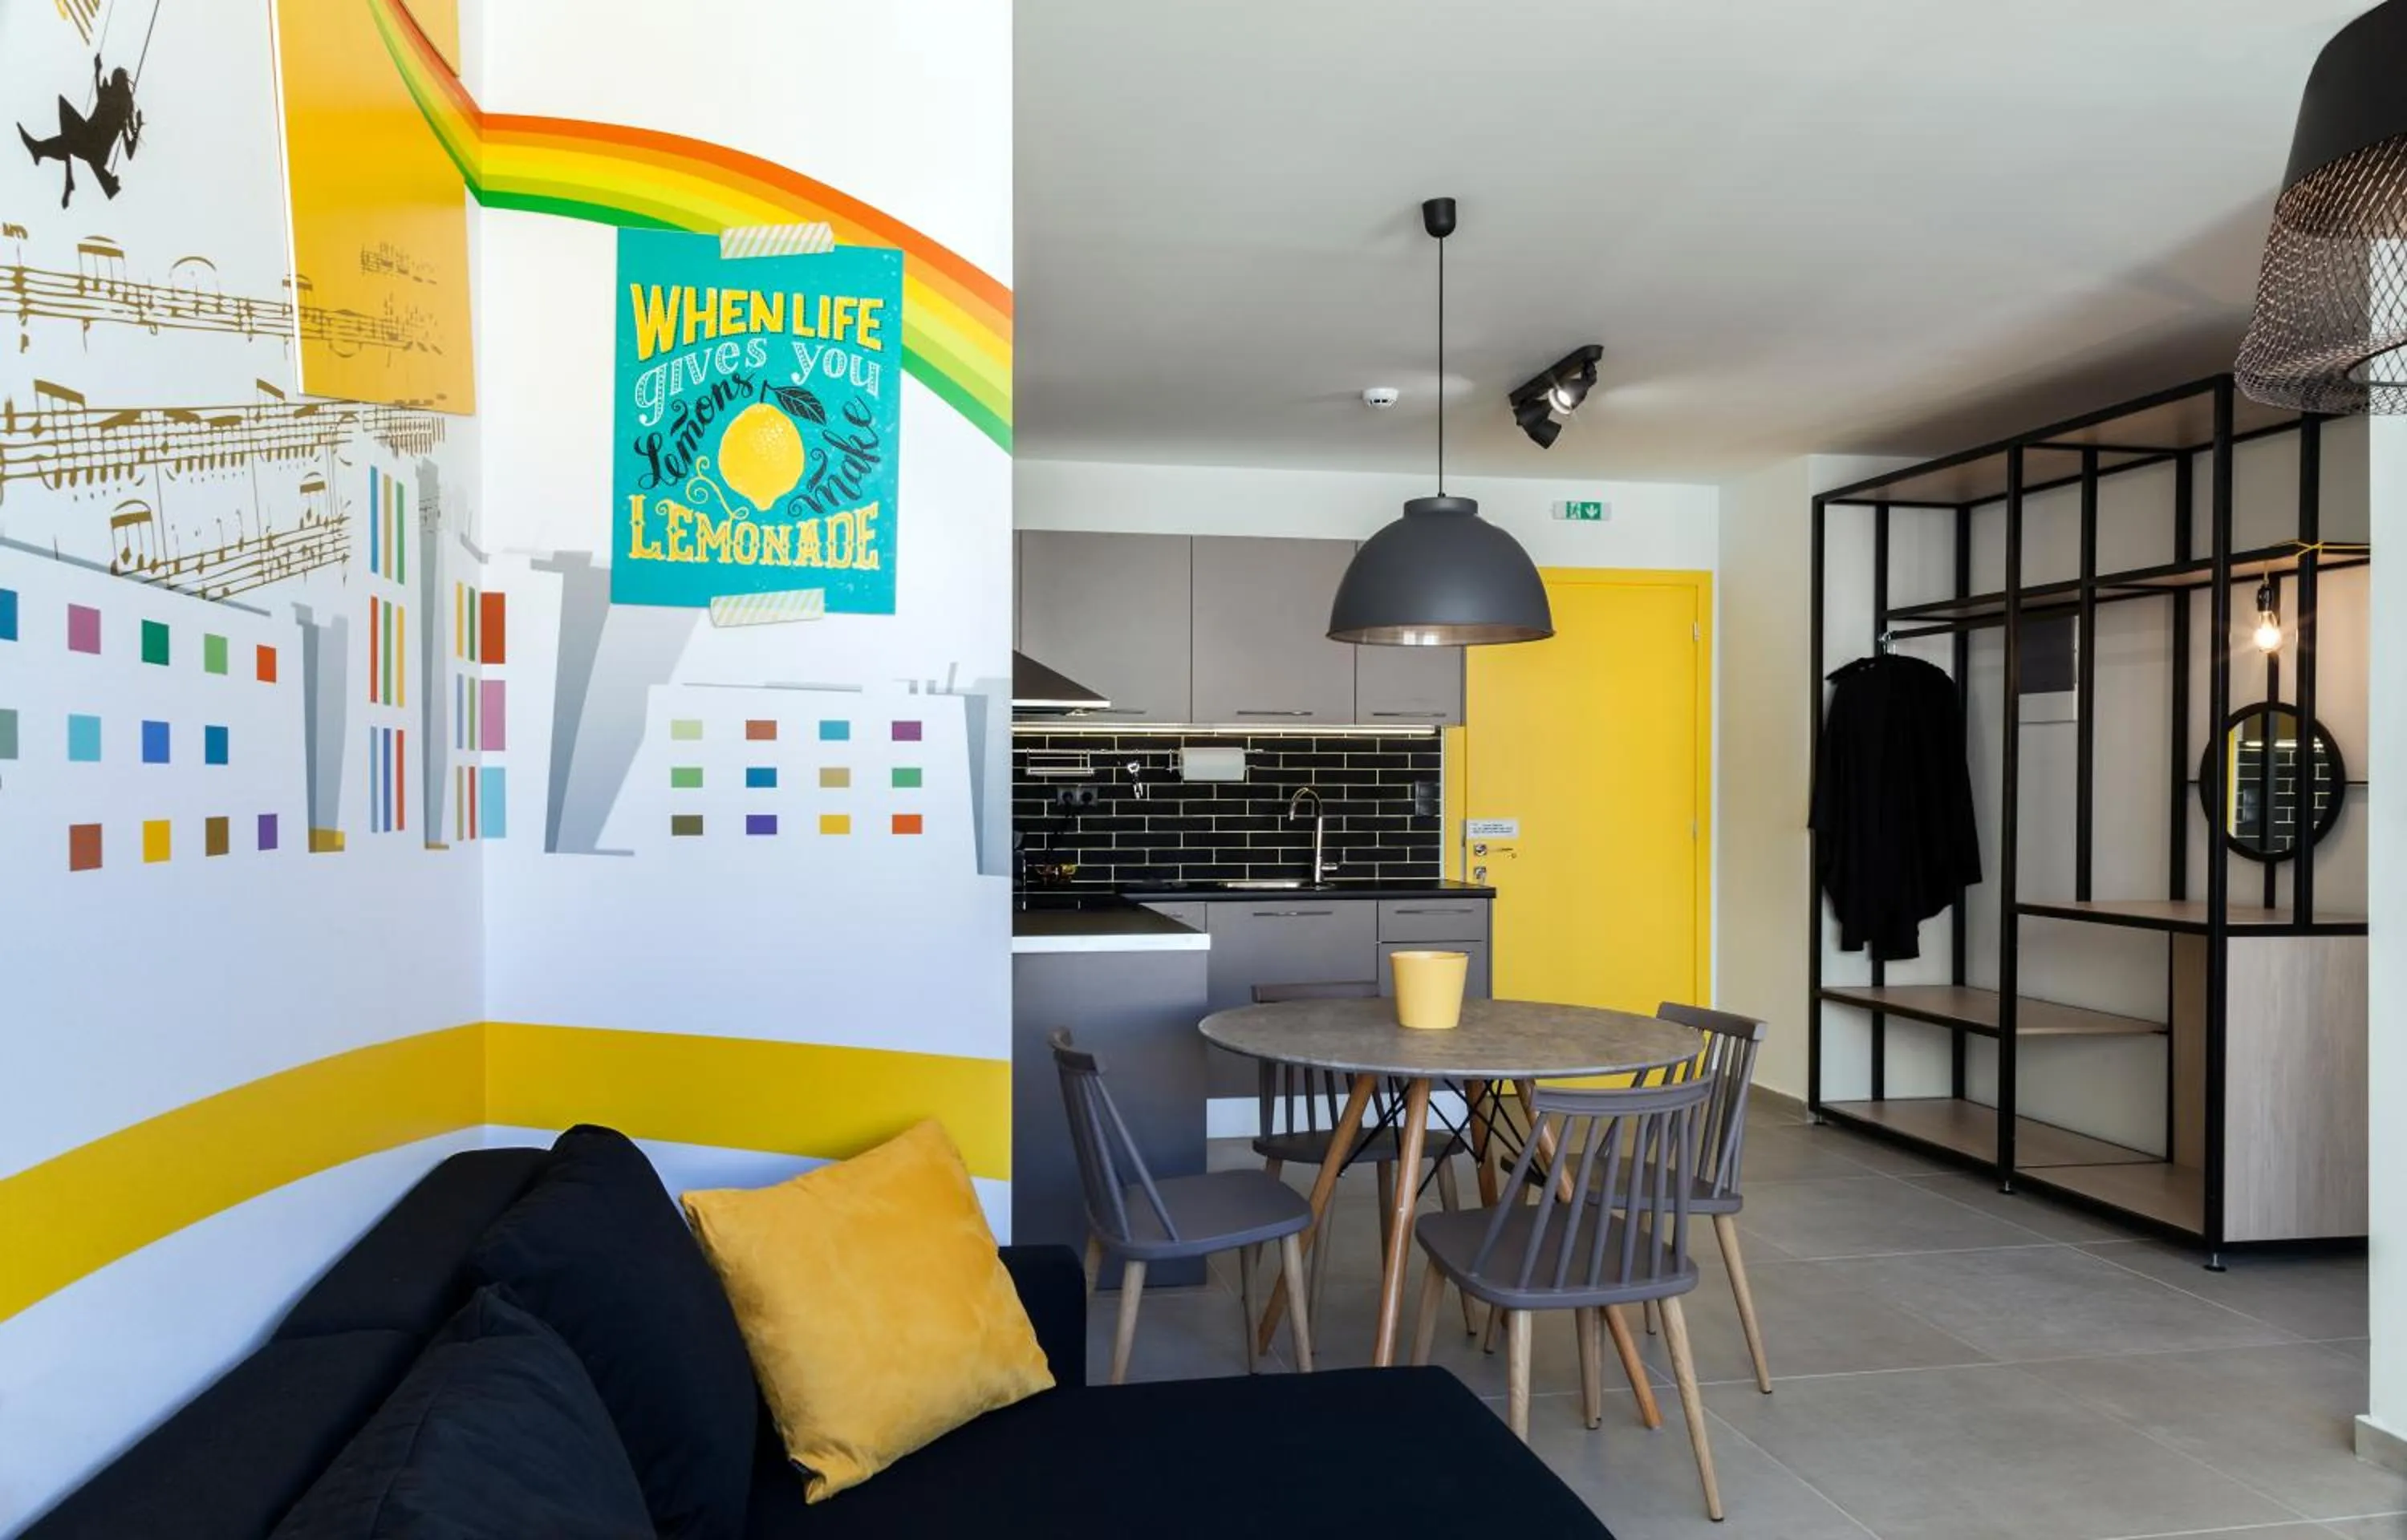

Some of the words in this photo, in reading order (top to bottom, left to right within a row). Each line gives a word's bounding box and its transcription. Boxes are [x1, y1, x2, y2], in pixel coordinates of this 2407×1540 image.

[630, 283, 784, 361] WHEN
[793, 293, 884, 351] LIFE
[635, 338, 768, 427] gives
[790, 341, 881, 399] you
[634, 372, 755, 489] Lemons
[788, 395, 880, 517] make
[629, 493, 880, 570] LEMONADE
